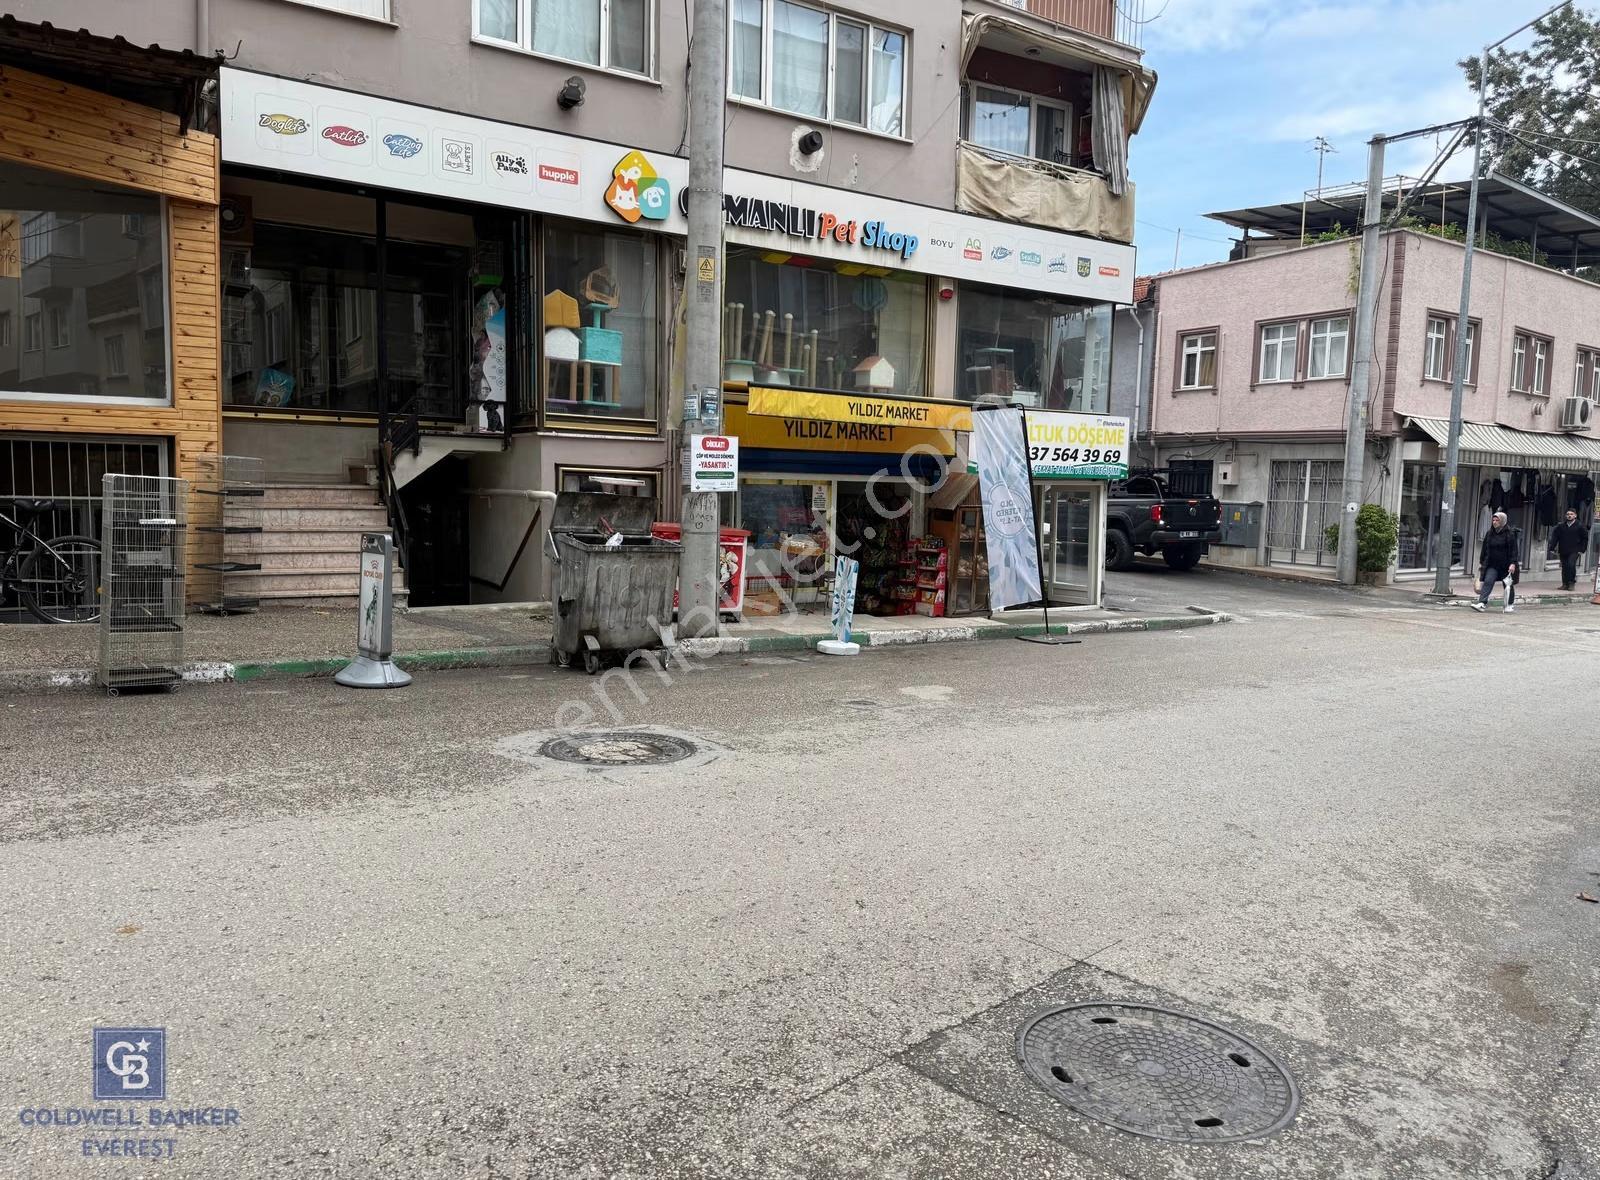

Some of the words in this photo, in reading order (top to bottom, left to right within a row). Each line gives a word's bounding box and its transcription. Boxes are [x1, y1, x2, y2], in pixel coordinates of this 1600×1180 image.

[259, 114, 307, 135] Doglife
[322, 127, 367, 145] Catlife
[383, 134, 423, 152] CatDog
[496, 154, 515, 166] Ally
[497, 161, 520, 174] Paws
[541, 167, 575, 182] hupple
[818, 212, 858, 244] Pet
[862, 220, 919, 258] Shop
[930, 238, 954, 249] BOYU
[848, 402, 883, 418] YILDIZ
[886, 406, 929, 422] MARKET
[784, 419, 832, 438] YILDIZ
[837, 421, 896, 441] MARKET
[1027, 423, 1064, 443] LTUK
[1068, 423, 1124, 447] DÖŞEME
[1028, 446, 1049, 461] 37
[1052, 448, 1079, 462] 564
[1082, 449, 1100, 463] 39
[1103, 450, 1121, 463] 69
